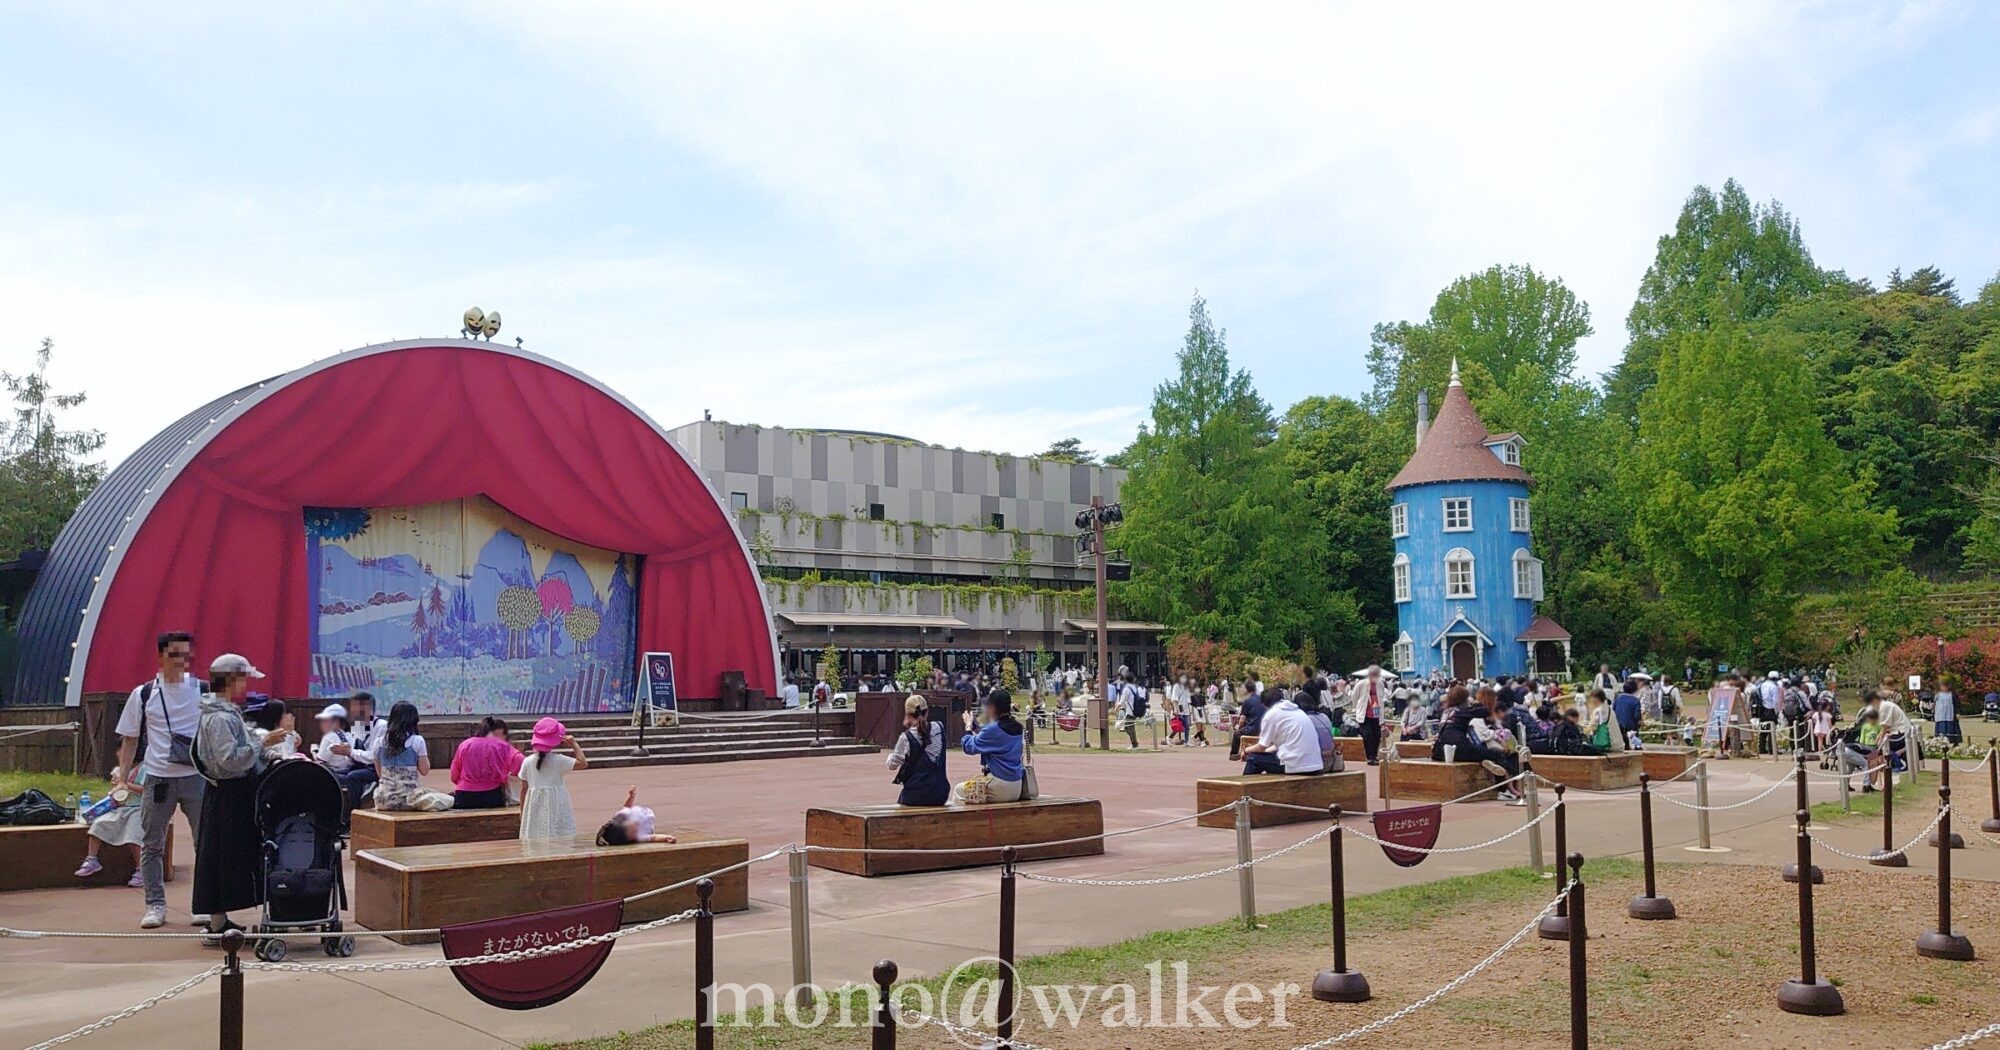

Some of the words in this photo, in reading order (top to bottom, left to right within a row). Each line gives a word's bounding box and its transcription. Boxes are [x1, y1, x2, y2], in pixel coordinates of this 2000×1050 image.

[483, 923, 590, 955] またがないでね
